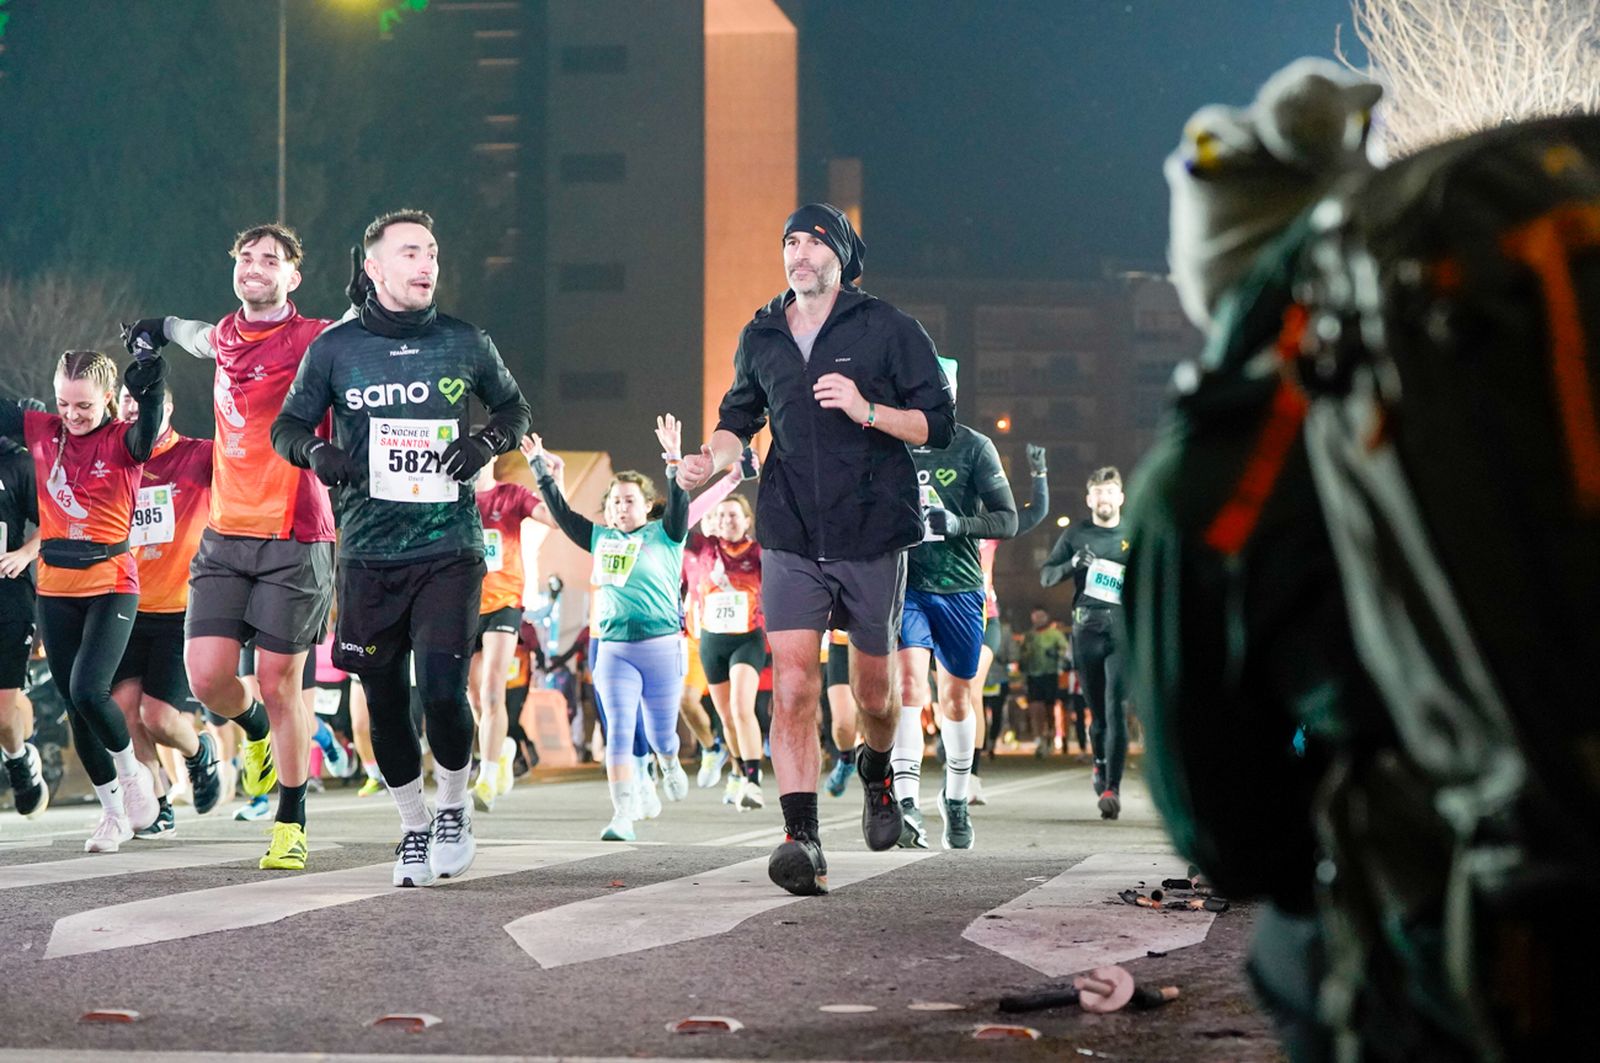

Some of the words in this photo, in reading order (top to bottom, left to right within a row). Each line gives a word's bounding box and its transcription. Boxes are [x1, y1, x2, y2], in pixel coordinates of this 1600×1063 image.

[345, 381, 429, 410] sano
[391, 429, 417, 437] NOCHE
[380, 438, 398, 446] SAN
[56, 489, 72, 508] 43
[131, 507, 163, 527] 985
[716, 606, 735, 619] 275
[341, 642, 364, 654] sano
